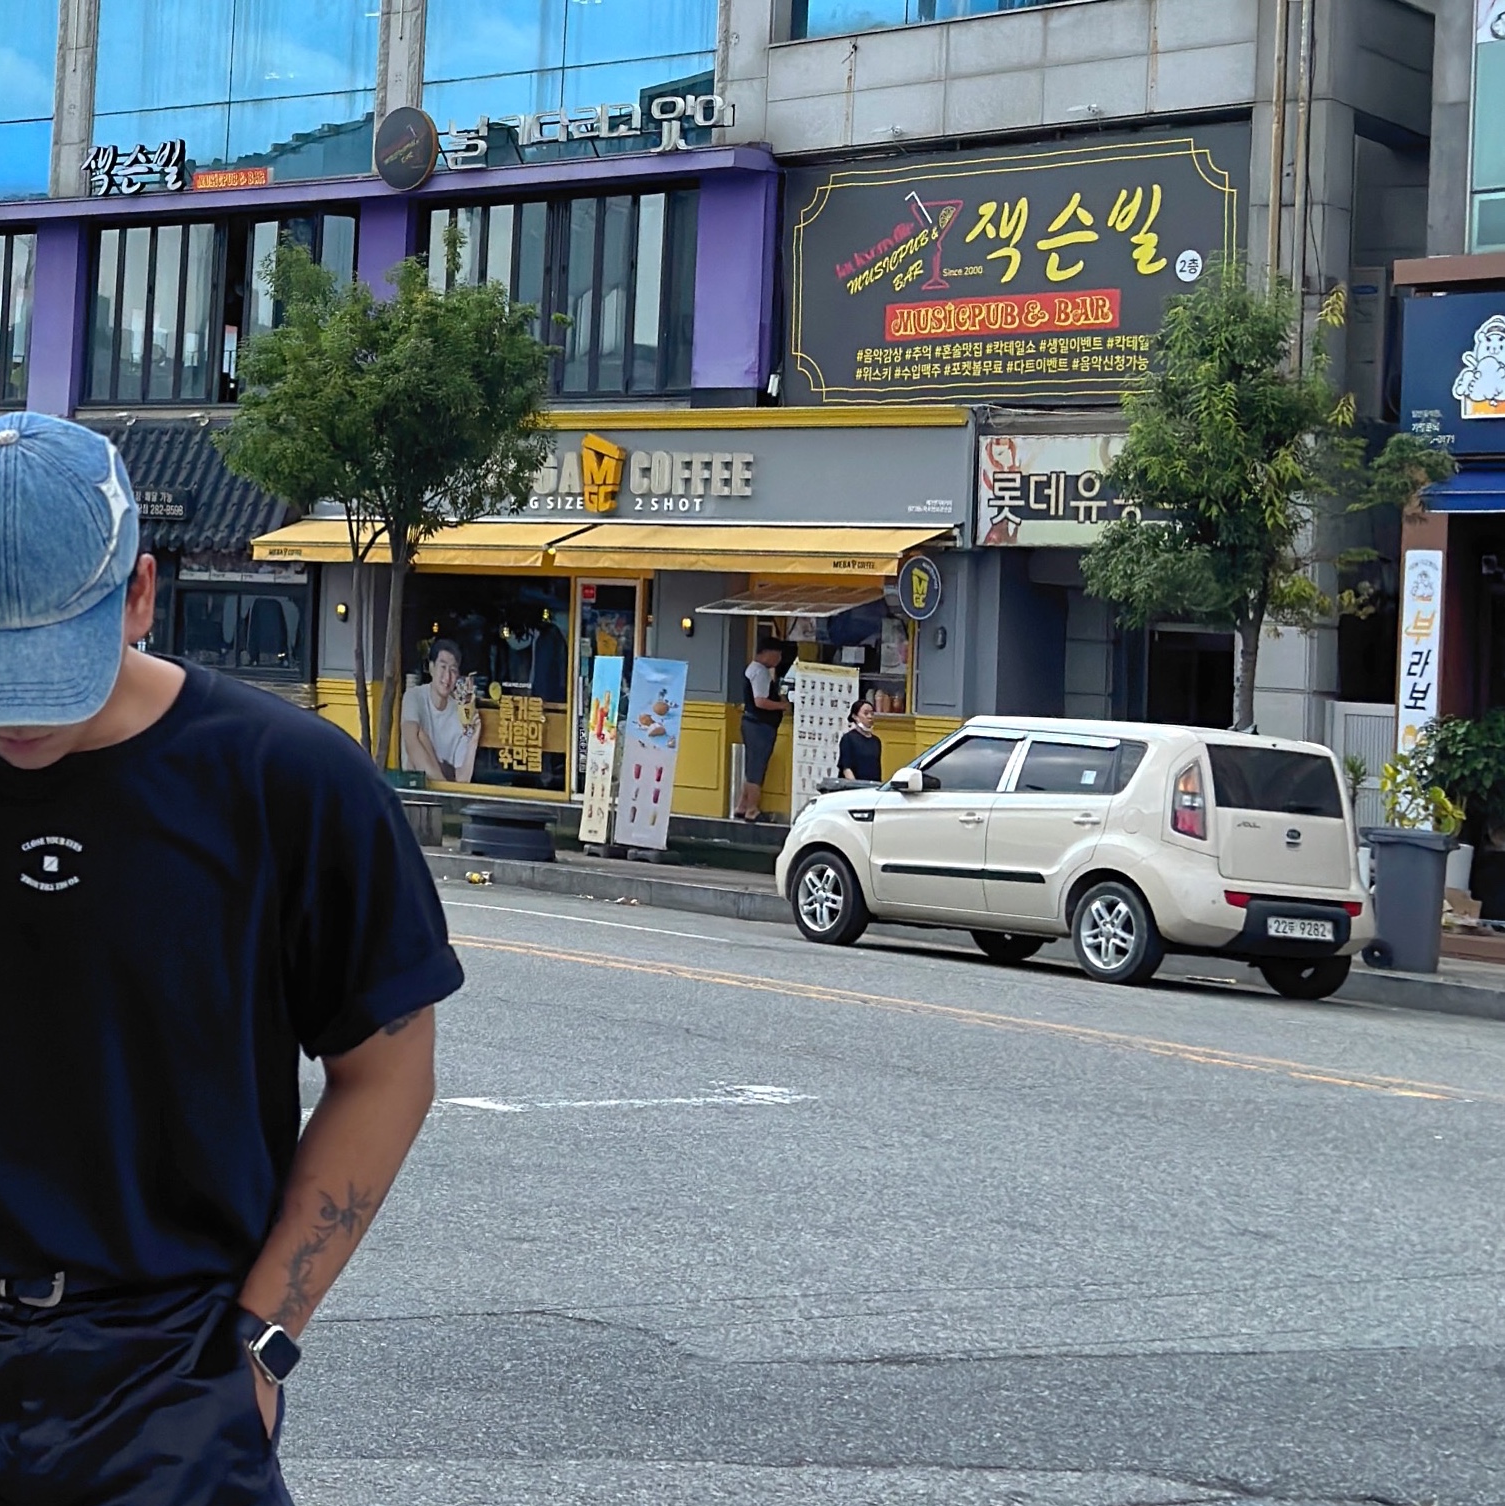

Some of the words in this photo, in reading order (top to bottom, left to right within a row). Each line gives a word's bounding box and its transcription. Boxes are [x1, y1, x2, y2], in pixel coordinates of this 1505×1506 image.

[81, 139, 186, 196] 잭슨빌
[965, 184, 1168, 283] 잭슨빌
[846, 228, 929, 295] MUSICPUB
[892, 259, 924, 292] BAR
[942, 267, 963, 277] Since
[964, 265, 983, 275] 2000
[1179, 258, 1199, 274] 2층
[1022, 300, 1049, 328] &
[1054, 296, 1113, 326] BAR
[856, 347, 903, 363] #음악감상
[905, 345, 932, 361] #추억
[935, 342, 983, 360] #혼술맛집
[986, 339, 1036, 356] #칵테일쇼
[1039, 337, 1103, 354] #생일이벤트
[855, 366, 892, 382] #위스키
[894, 363, 941, 380] #수입맥주
[1006, 357, 1069, 374] #다트이벤트
[1072, 354, 1149, 372] #음악신청가능
[533, 451, 581, 495] GA
[629, 451, 754, 496] COFFEE
[546, 496, 584, 511] SIZE
[634, 498, 643, 511] 2
[650, 497, 703, 512] SHOT
[833, 560, 850, 569] MEGA
[1299, 921, 1327, 938] 9282
